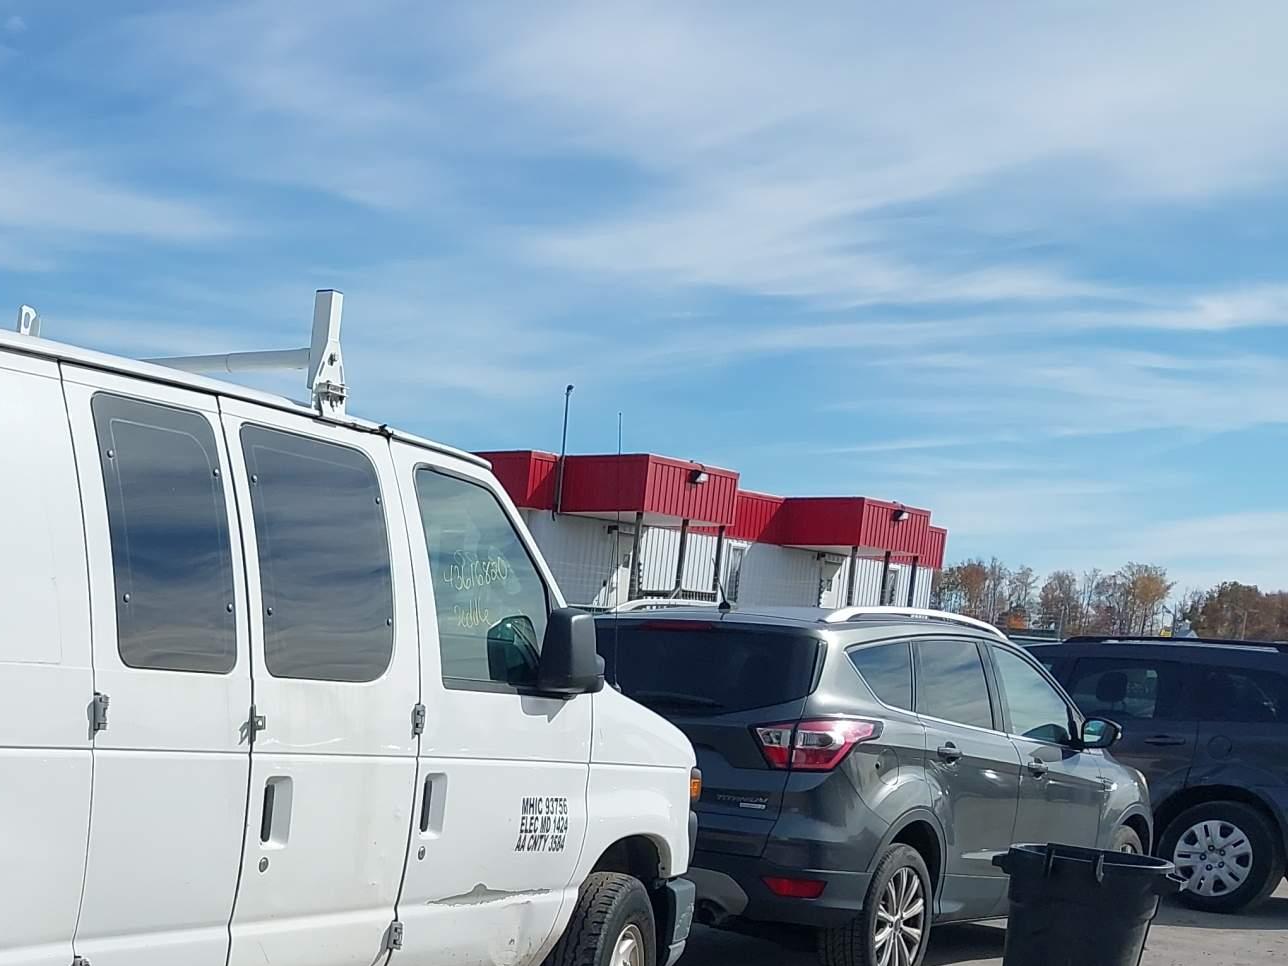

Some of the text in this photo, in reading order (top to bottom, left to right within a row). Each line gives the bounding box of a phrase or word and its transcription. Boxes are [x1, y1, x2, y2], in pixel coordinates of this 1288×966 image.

[443, 556, 508, 590] 43616820
[521, 797, 568, 815] MHIC 93756
[520, 816, 568, 834] ELEC MD 1424
[515, 834, 527, 852] AA
[527, 834, 549, 852] CNTY
